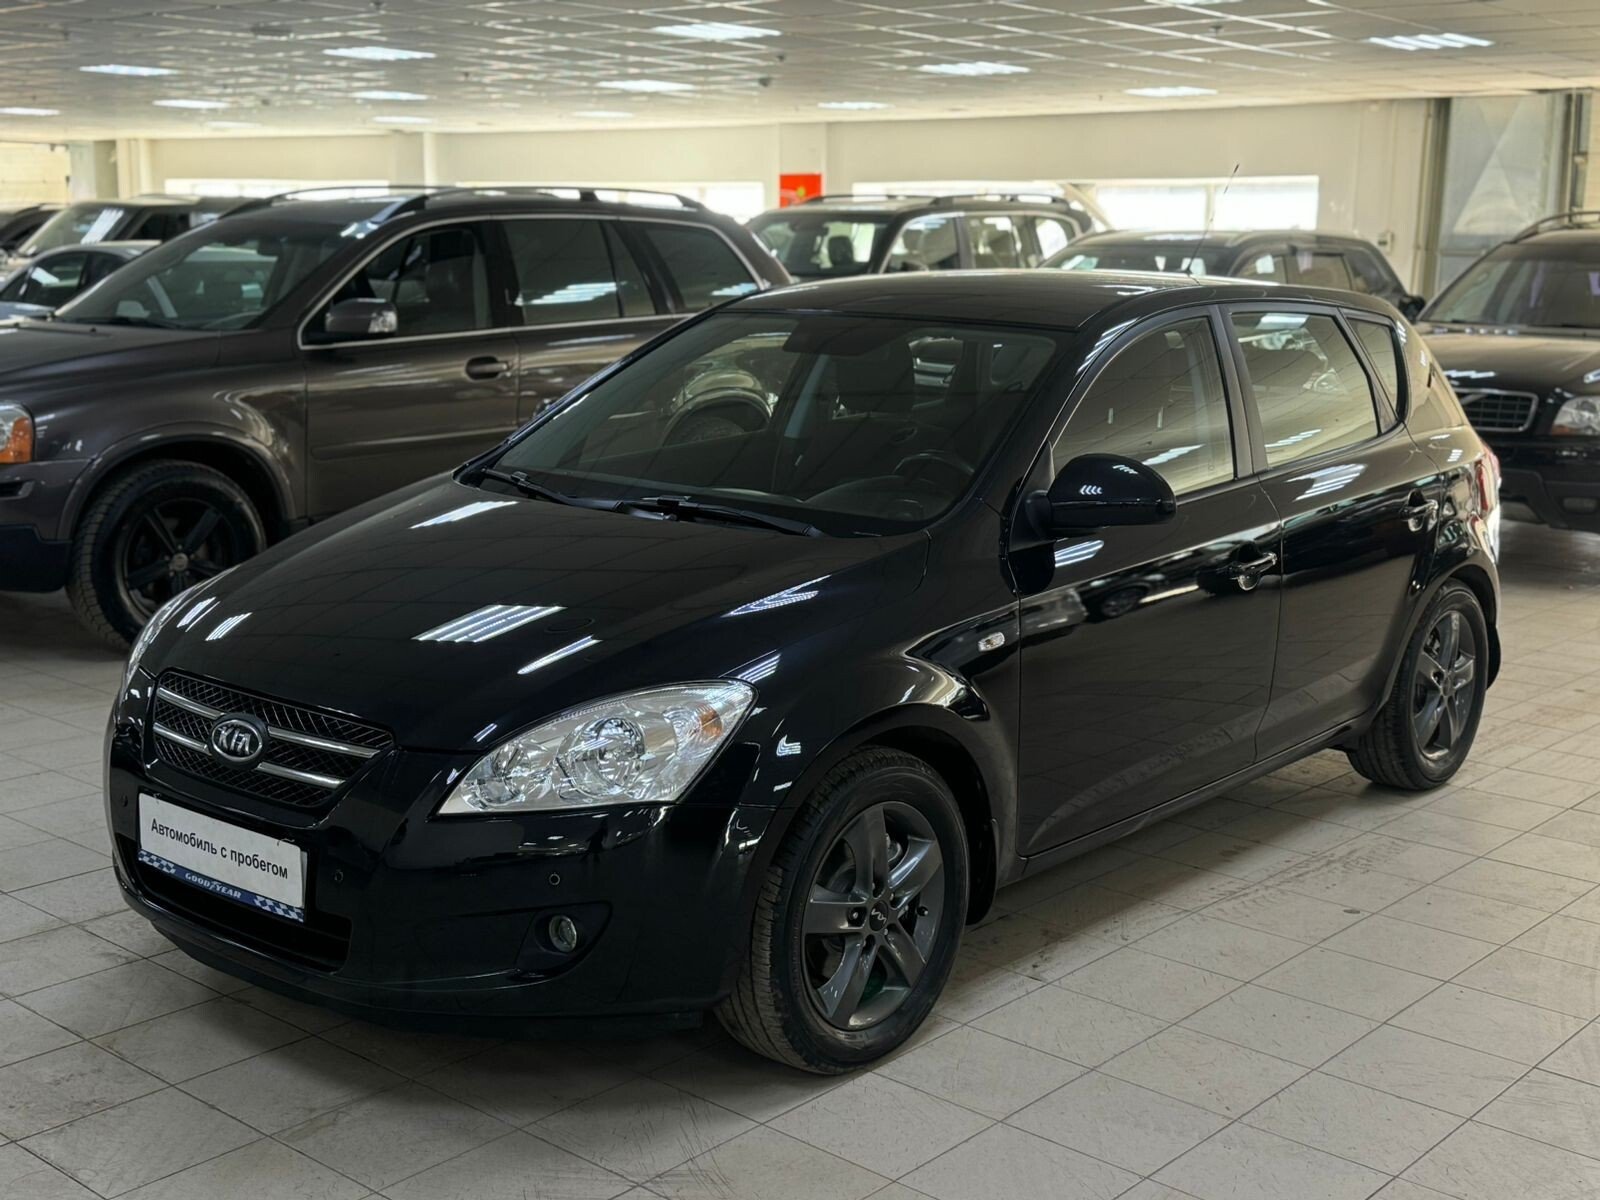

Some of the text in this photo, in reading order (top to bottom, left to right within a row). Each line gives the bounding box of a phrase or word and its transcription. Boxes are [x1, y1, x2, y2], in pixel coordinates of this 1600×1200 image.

[217, 726, 251, 755] KIA
[151, 818, 288, 879] Автомобиль с пробегом
[185, 872, 242, 899] GOODYEAR
